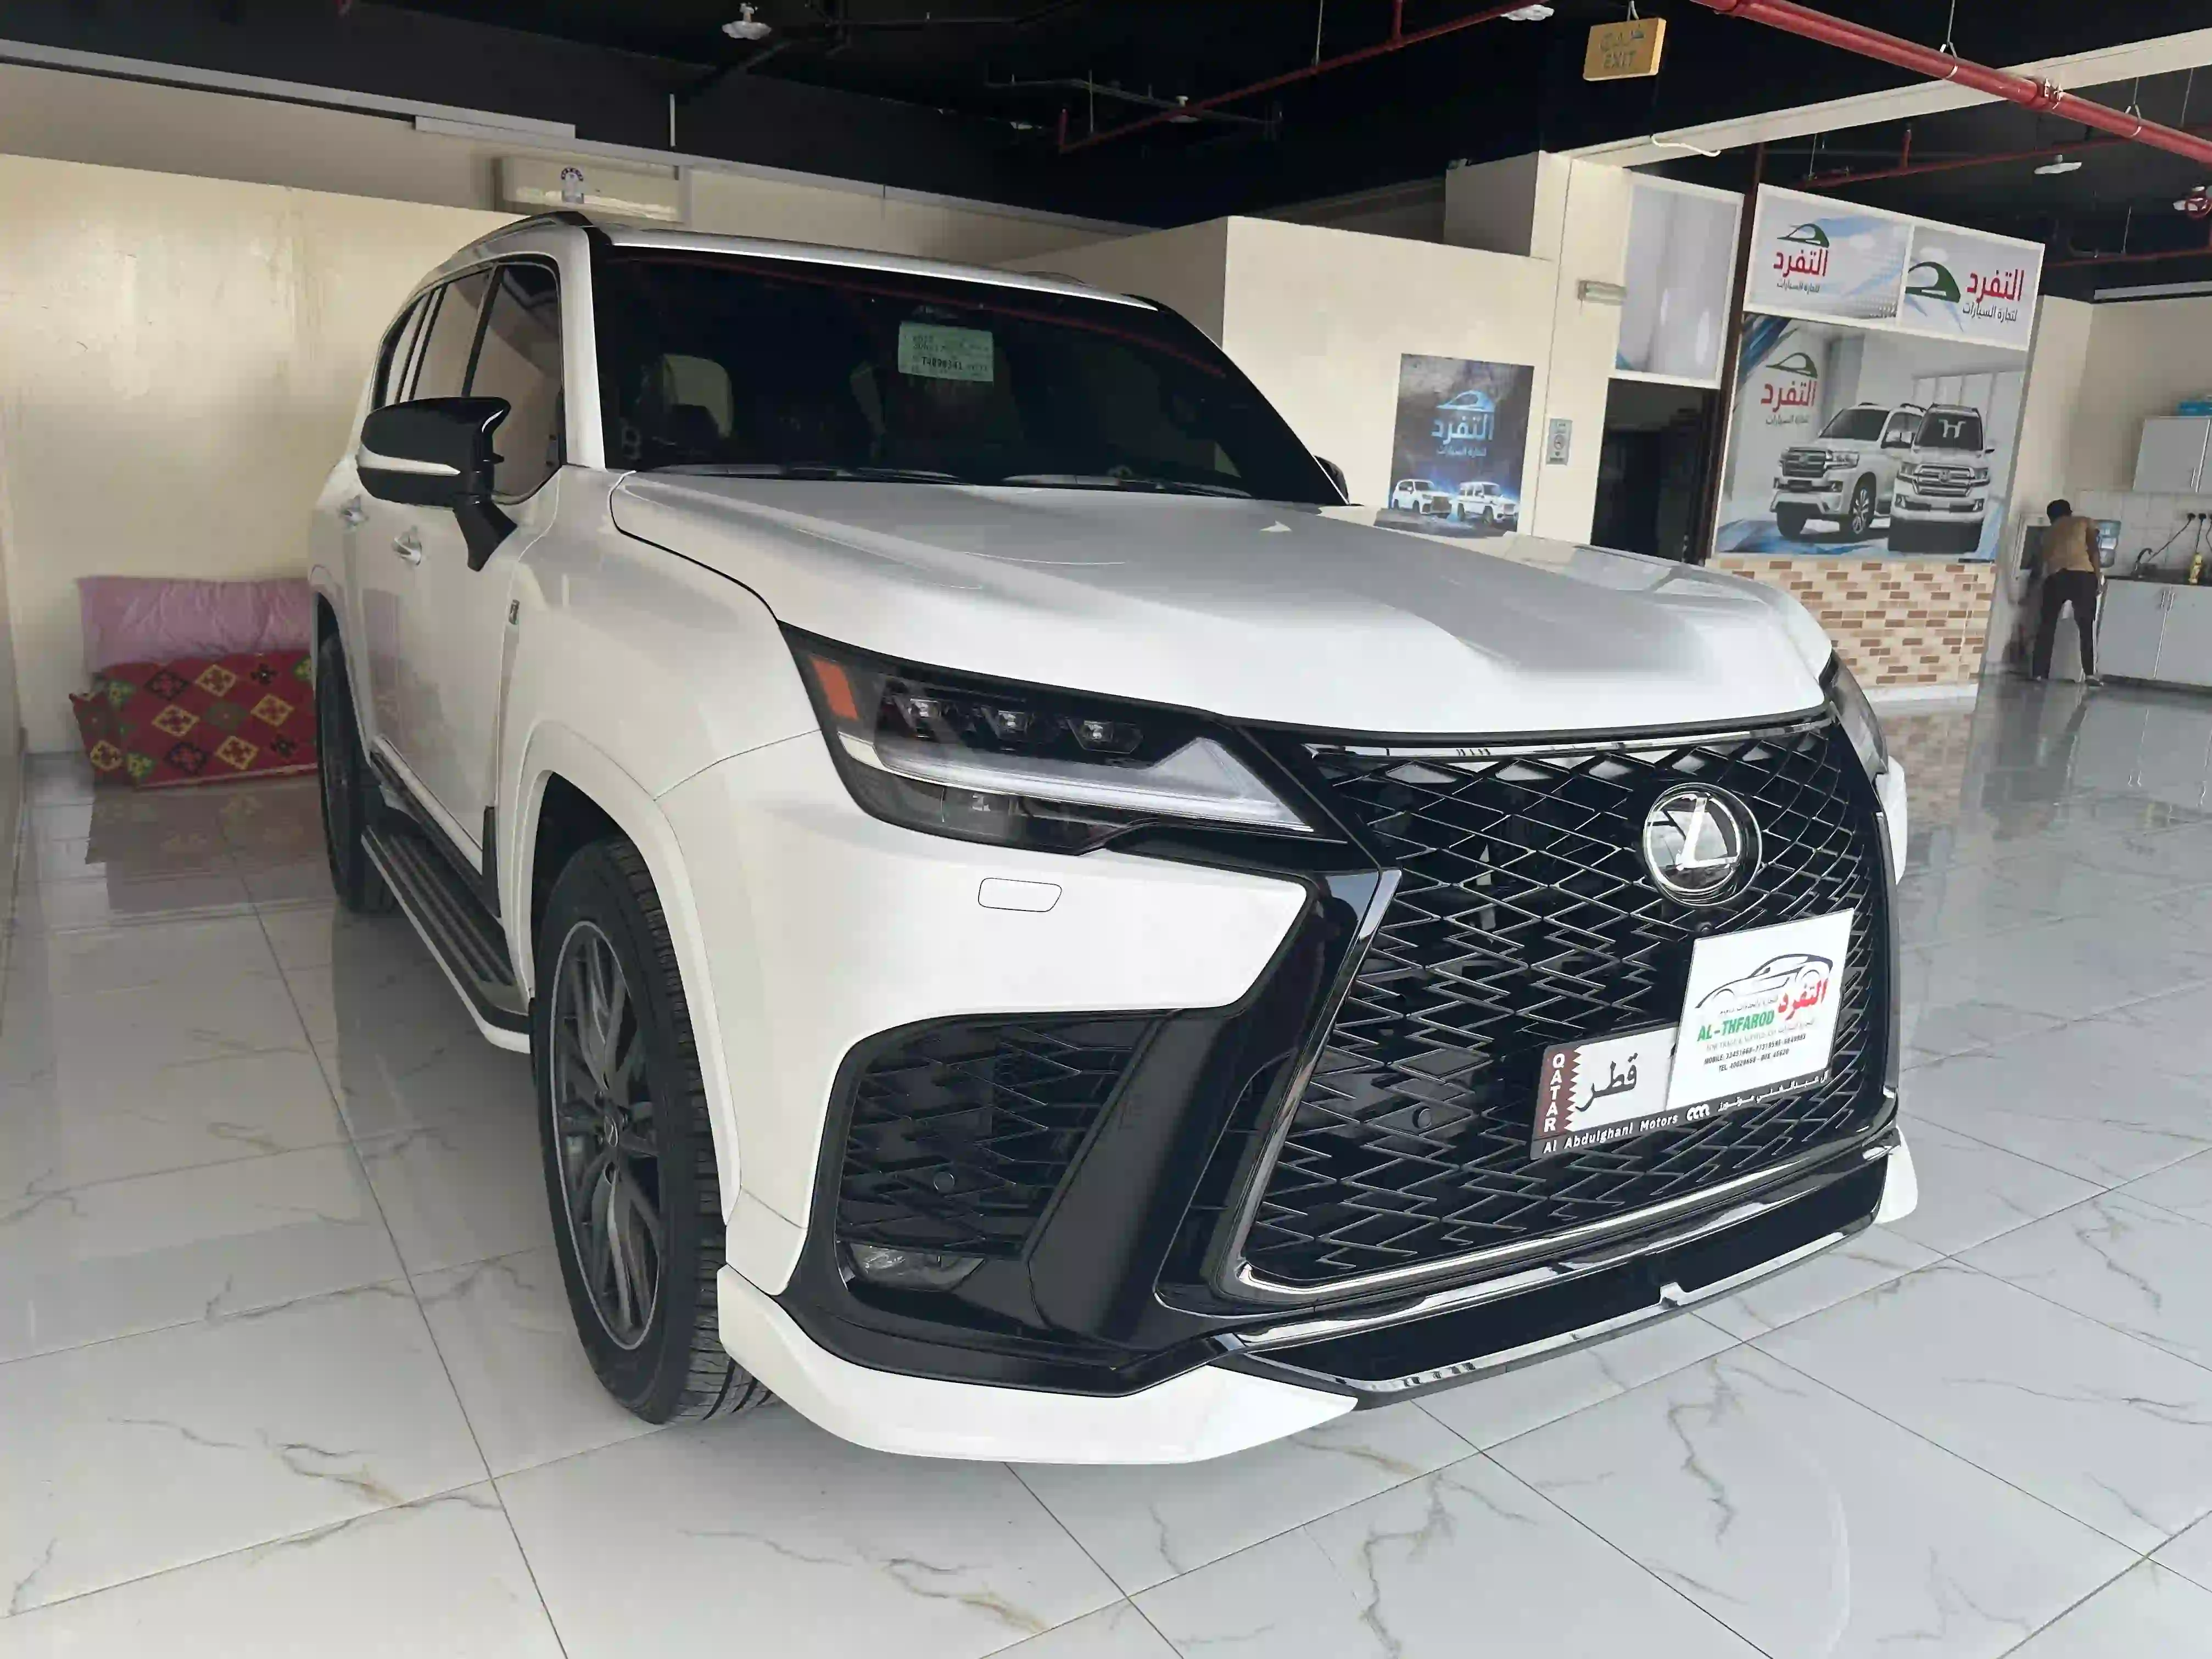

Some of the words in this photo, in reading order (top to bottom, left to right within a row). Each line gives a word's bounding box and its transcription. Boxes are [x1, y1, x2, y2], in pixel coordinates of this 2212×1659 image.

[1773, 248, 1829, 277] التفرد
[1967, 269, 2024, 302] التفرد
[1962, 302, 1997, 319] السيارات
[1997, 307, 2018, 323] لتجارة
[1760, 379, 1817, 412] التفرد
[1431, 413, 1494, 445] التفرد
[1778, 977, 1829, 1020] التفرد
[1704, 1054, 1724, 1065] MOBILE
[1719, 1064, 1727, 1072] TEL
[1543, 1053, 1565, 1132] QATAR
[1574, 1052, 1638, 1113] قطر
[1543, 1141, 1557, 1154] Al
[1563, 1122, 1633, 1149] Abdulghani
[1640, 1114, 1679, 1132] Motors
